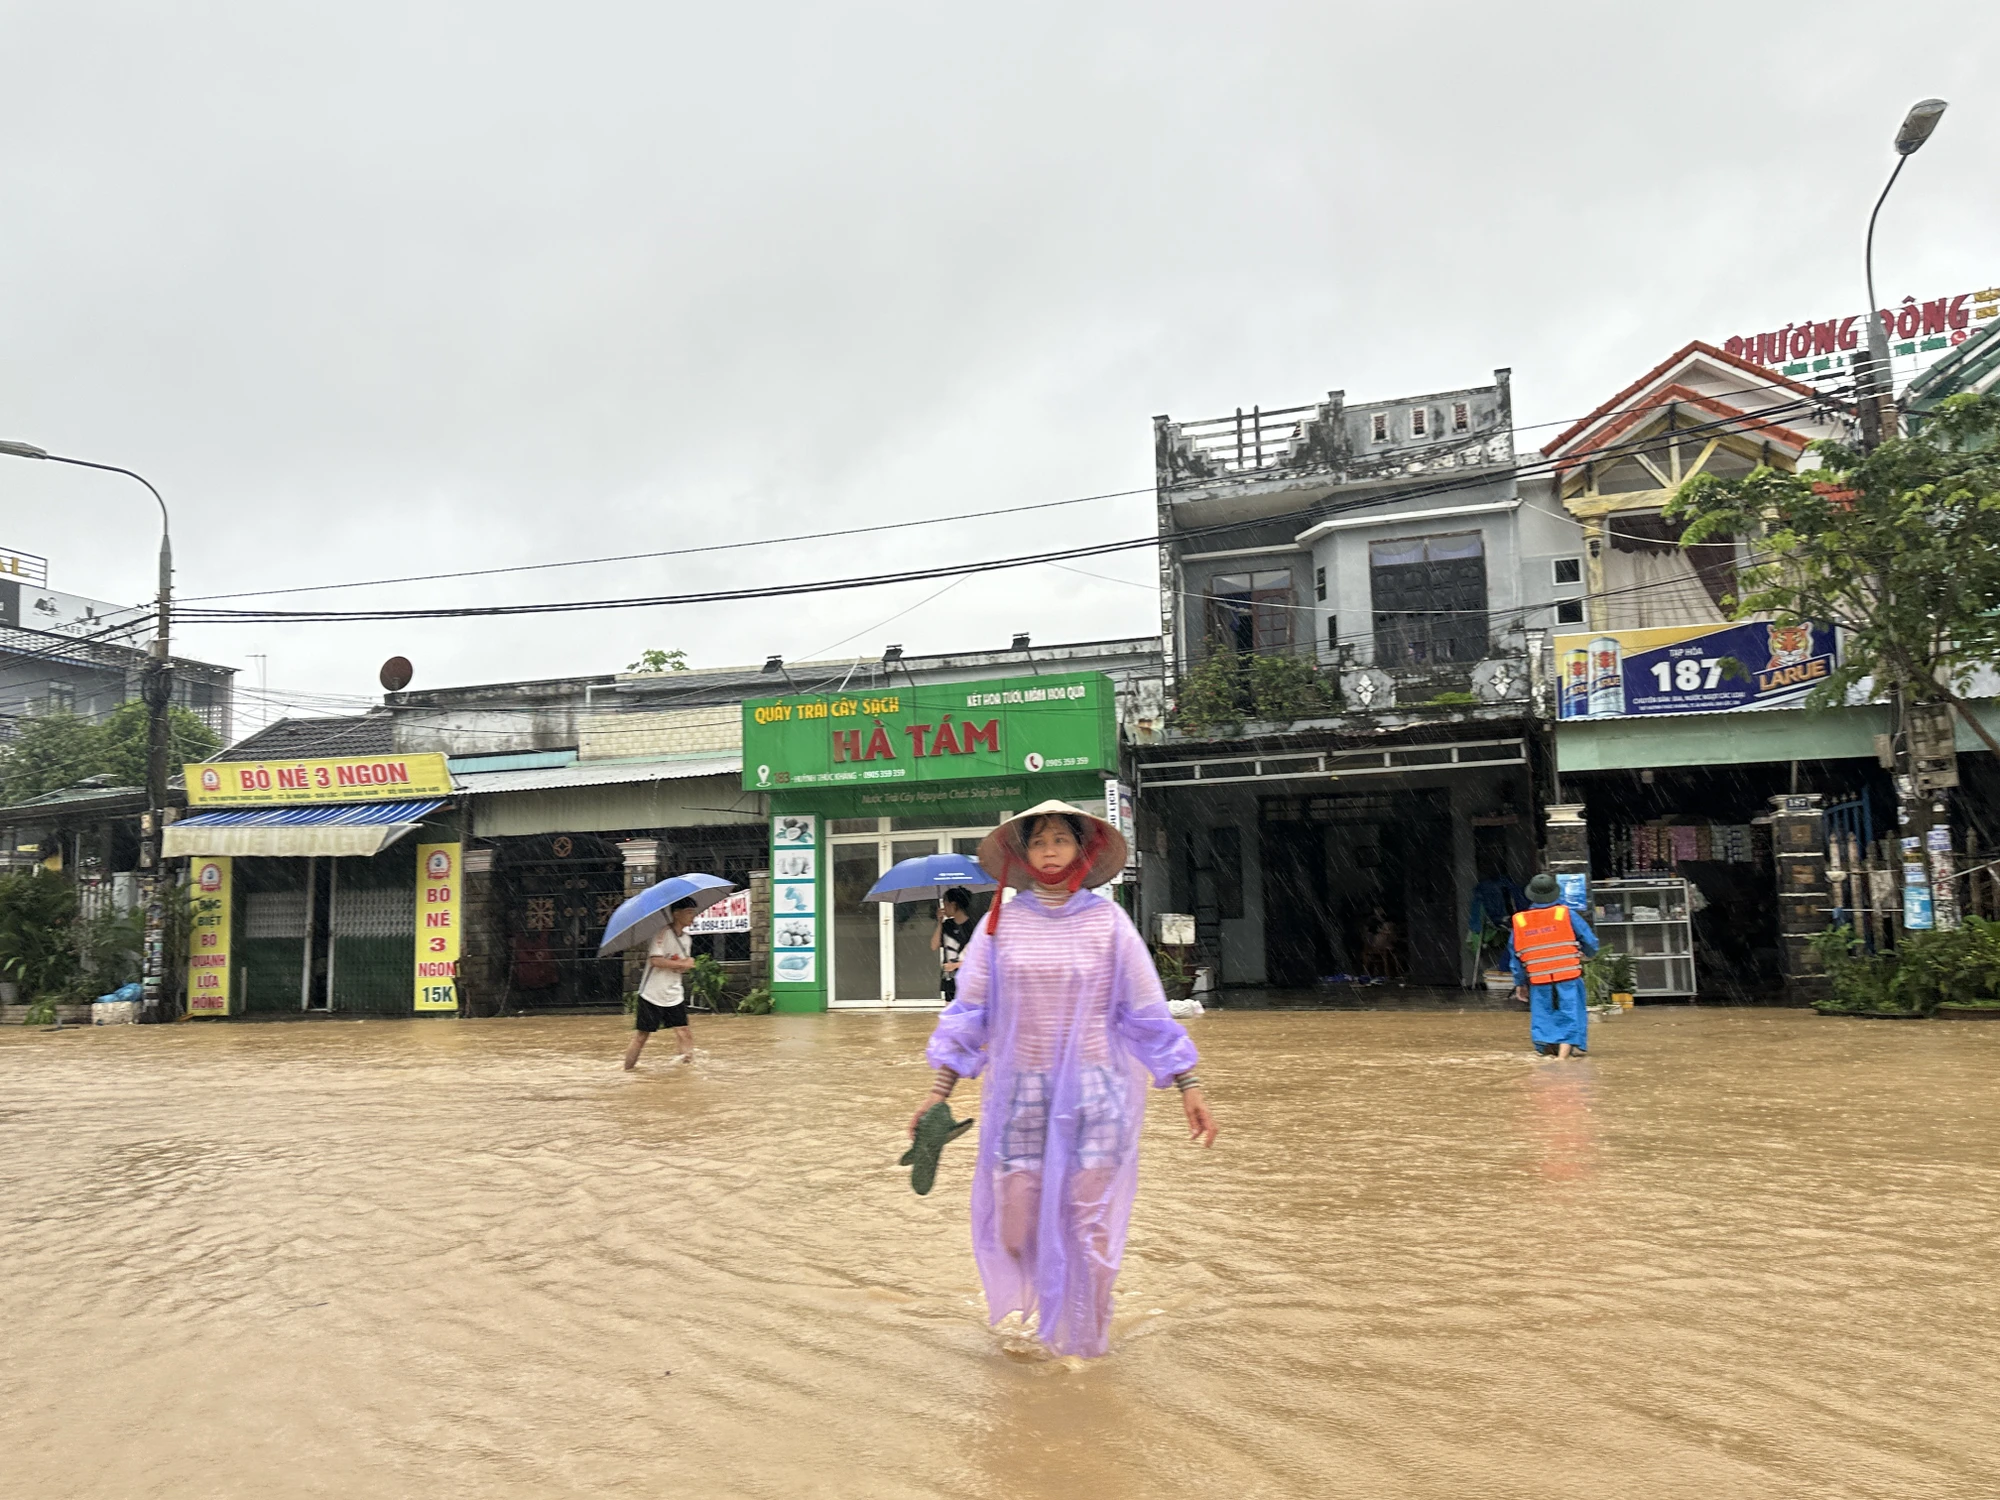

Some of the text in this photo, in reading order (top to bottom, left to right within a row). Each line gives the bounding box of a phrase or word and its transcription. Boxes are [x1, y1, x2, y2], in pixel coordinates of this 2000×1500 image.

[1650, 658, 1724, 692] 187
[1760, 659, 1827, 690] LARUE
[966, 690, 982, 707] KẾT
[983, 693, 1001, 706] HOA
[1047, 687, 1066, 700] HOA
[796, 699, 829, 720] TRÁI
[830, 698, 859, 717] CÂY
[862, 696, 900, 717] SẠCH
[833, 713, 1001, 763] HÀ TÁM
[1045, 758, 1062, 768] 0905
[276, 764, 310, 789] NÉ
[314, 767, 331, 788] 3
[336, 762, 410, 786] NGON
[774, 772, 791, 784] 183
[426, 909, 452, 928] NÉ
[429, 937, 447, 952] 3
[418, 961, 457, 977] NGON
[421, 985, 455, 1003] 15K
